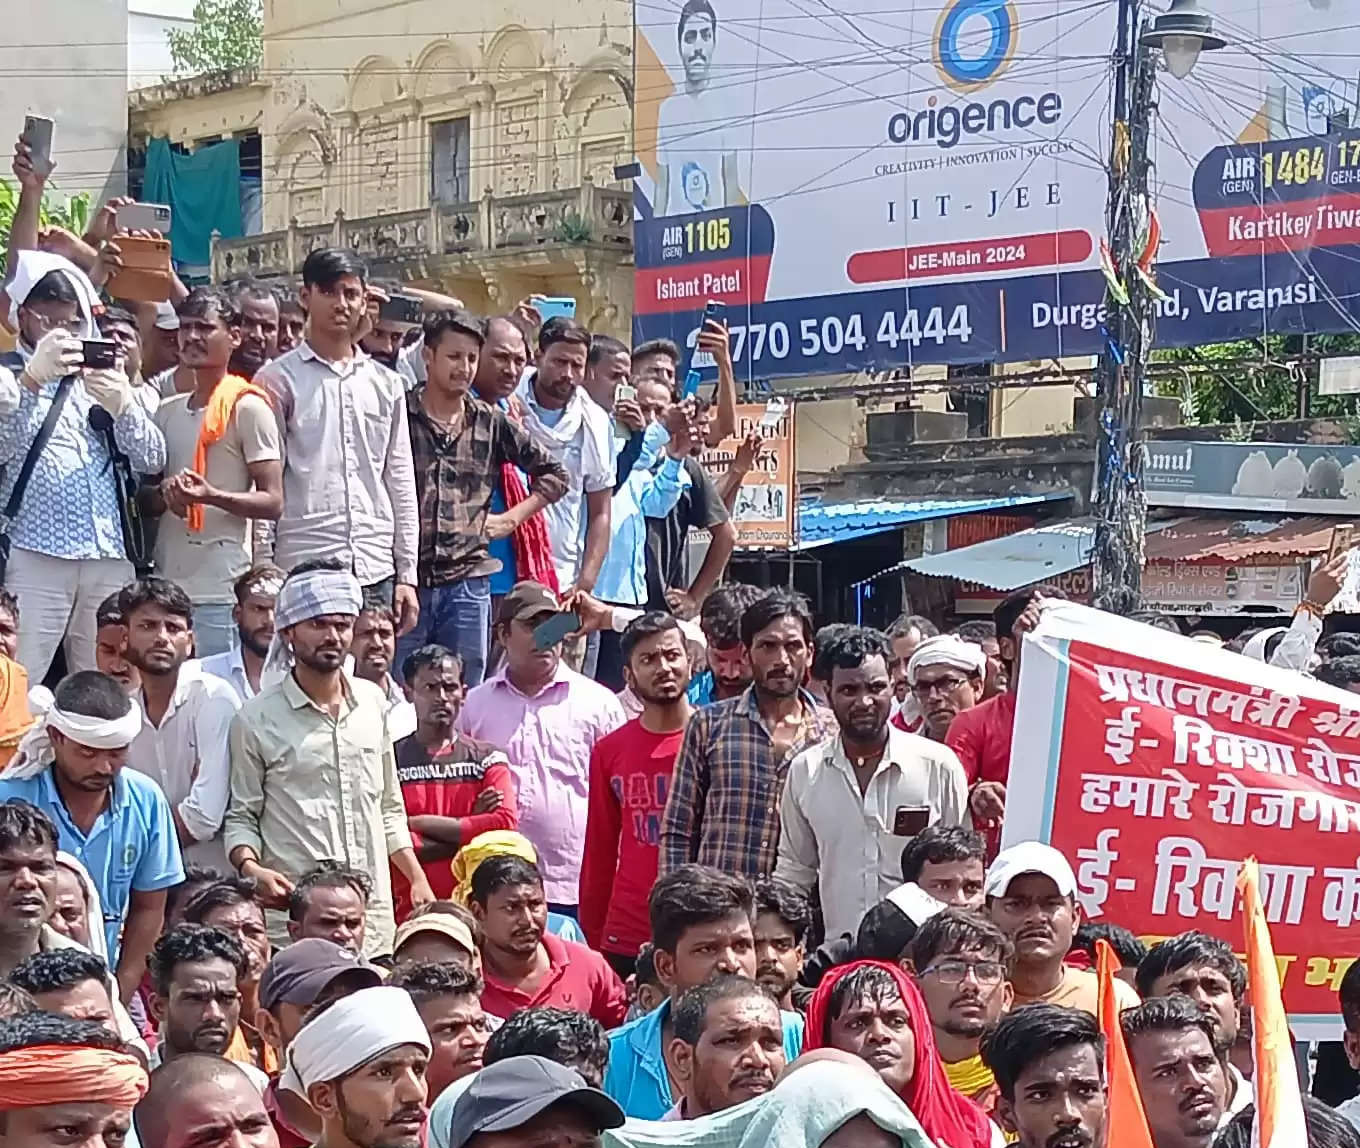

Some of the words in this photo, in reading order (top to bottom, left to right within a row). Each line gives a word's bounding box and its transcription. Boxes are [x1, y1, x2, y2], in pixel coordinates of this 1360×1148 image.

[888, 92, 1062, 149] origence
[875, 157, 937, 177] CREATIVITY
[946, 148, 1017, 169] INNOVATION
[1222, 157, 1255, 180] AIR
[1262, 147, 1325, 188] 1484
[1222, 180, 1255, 195] (GEN)
[662, 226, 684, 247] AIR
[685, 217, 731, 253] 1105
[1228, 211, 1314, 241] Kartikey
[908, 249, 981, 271] JEE-Main
[986, 244, 1026, 263] 2024
[656, 276, 700, 300] Ishant
[703, 269, 741, 295] Patel
[728, 321, 791, 363] 770
[800, 313, 867, 357] 504
[876, 304, 973, 349] 4444
[1093, 664, 1305, 730] प्रधानमंत्री
[1173, 713, 1299, 778] रिक्शा
[1080, 768, 1200, 820] हमारे
